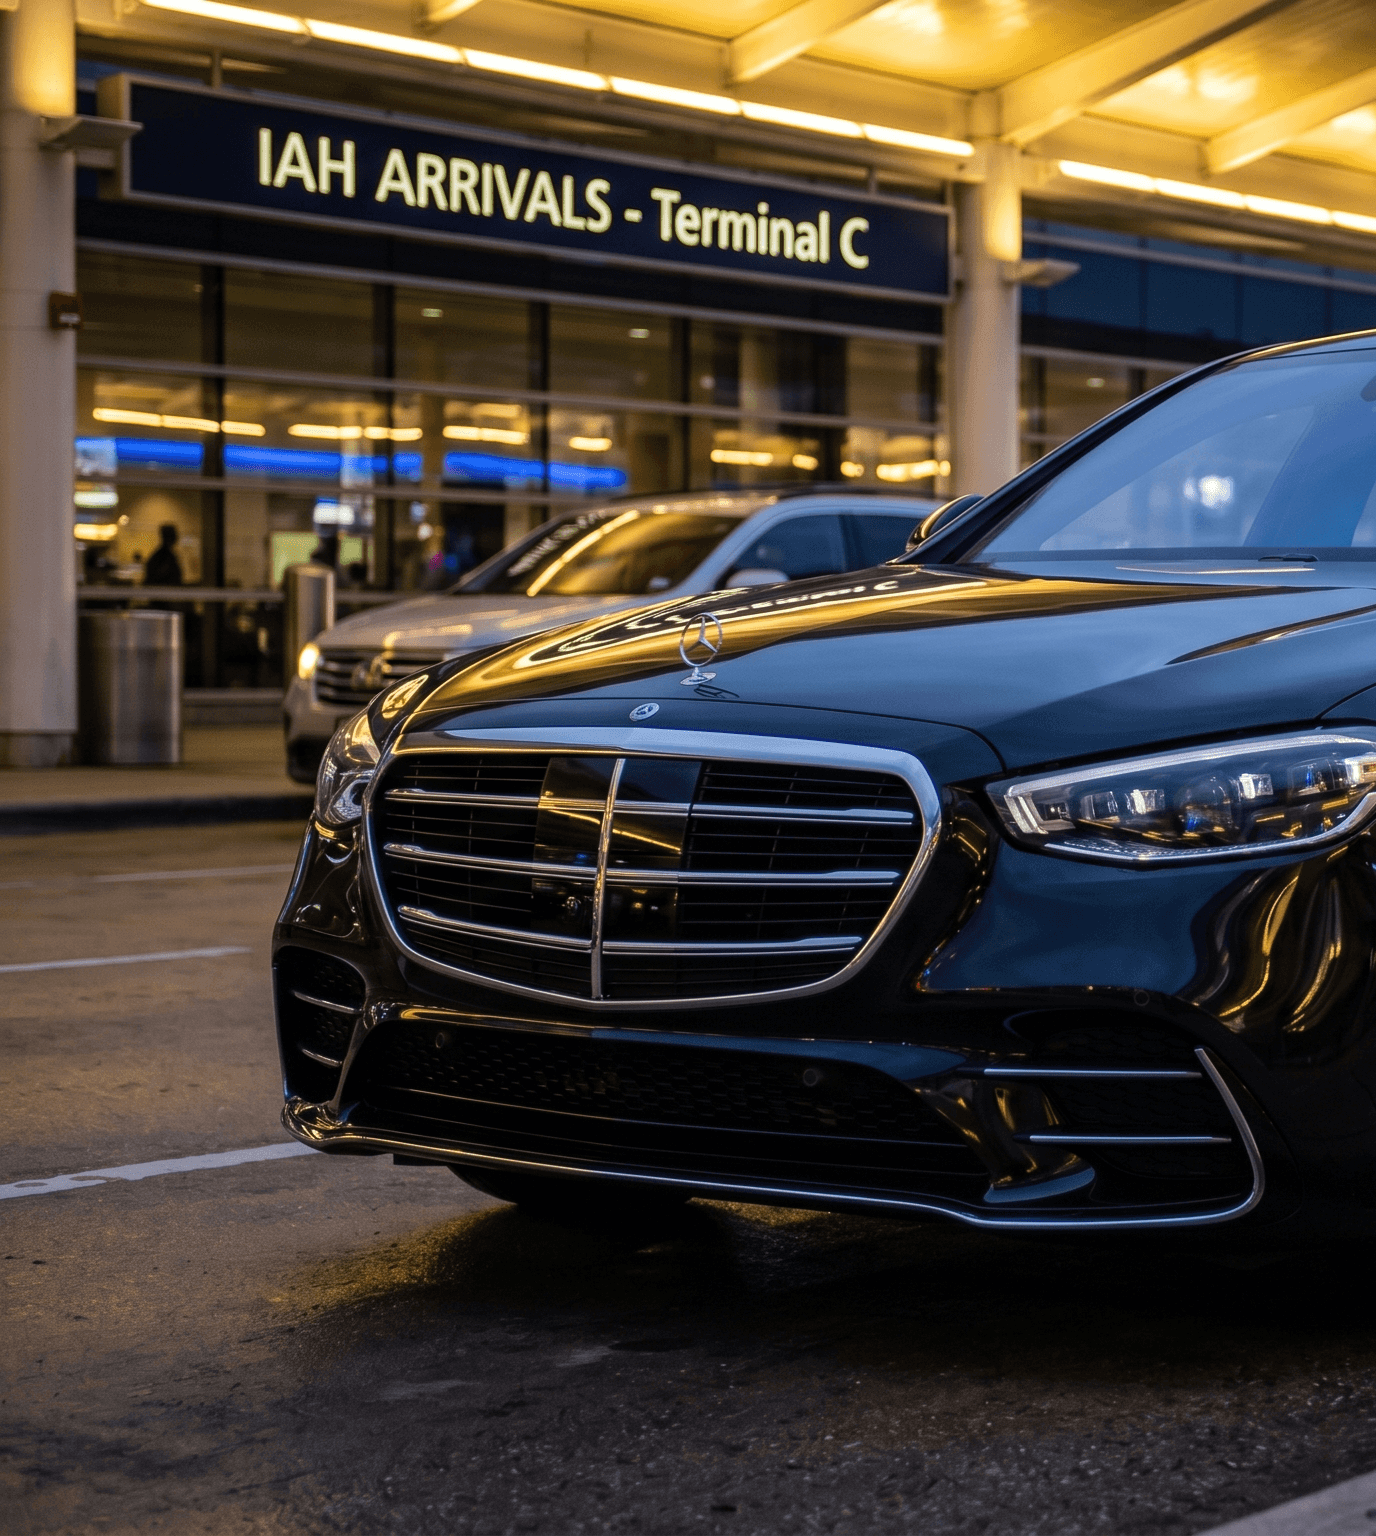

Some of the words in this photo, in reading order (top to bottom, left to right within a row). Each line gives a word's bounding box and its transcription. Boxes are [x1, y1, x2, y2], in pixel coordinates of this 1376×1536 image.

[258, 127, 355, 198] IAH
[375, 148, 612, 233] ARRIVALS
[624, 208, 643, 223] -
[650, 187, 830, 264] Terminal
[839, 217, 869, 269] C
